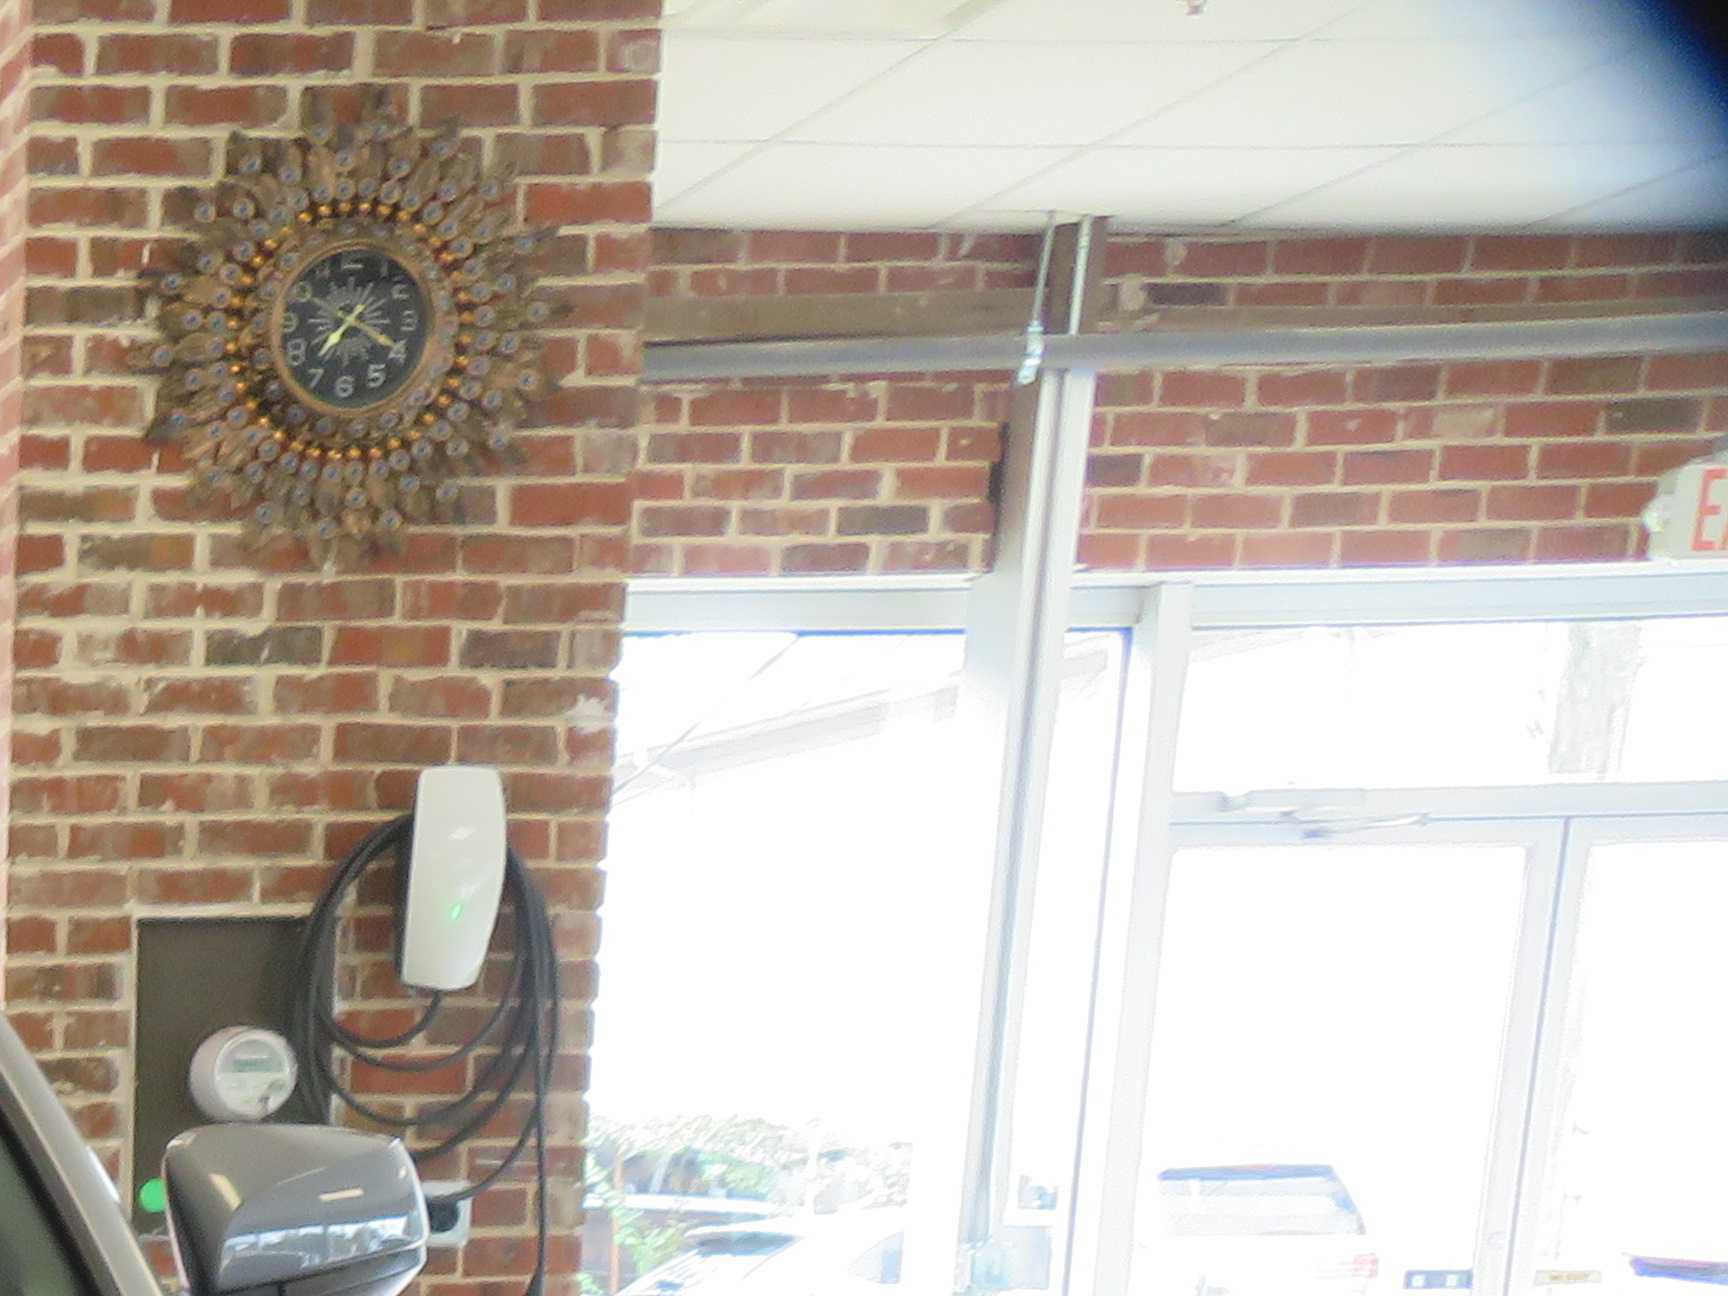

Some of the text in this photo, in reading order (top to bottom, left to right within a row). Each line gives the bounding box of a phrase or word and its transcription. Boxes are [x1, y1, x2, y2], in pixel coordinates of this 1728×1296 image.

[287, 339, 307, 367] 8
[307, 367, 325, 390] 7
[334, 374, 355, 399] 6
[367, 363, 387, 389] 5
